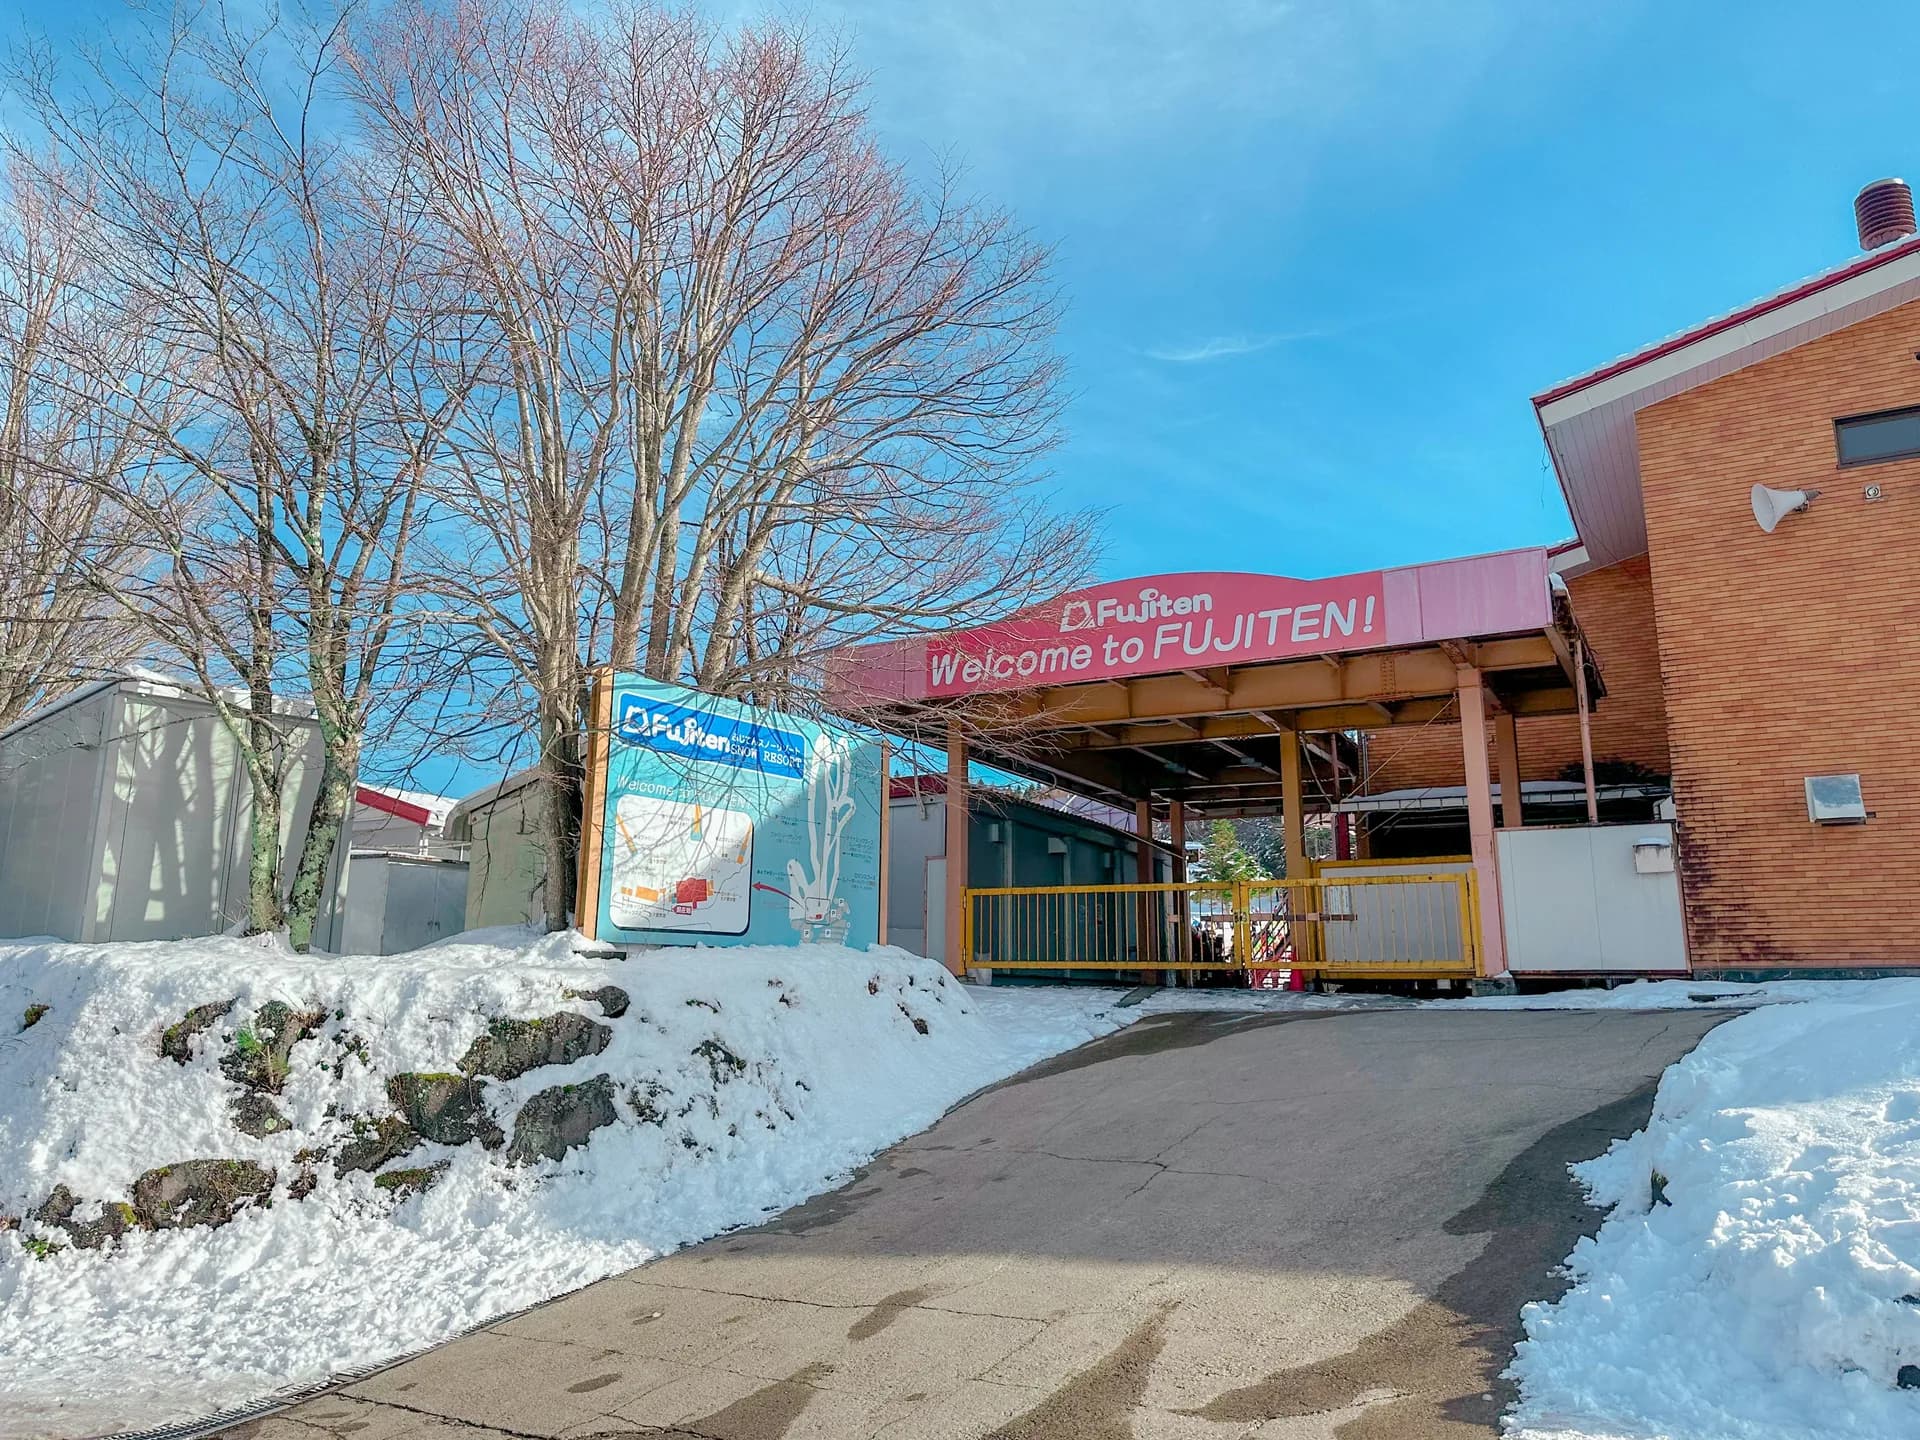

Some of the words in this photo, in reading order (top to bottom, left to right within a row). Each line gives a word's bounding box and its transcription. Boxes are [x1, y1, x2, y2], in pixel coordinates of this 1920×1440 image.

[1097, 588, 1213, 626] Fujiten
[931, 644, 1093, 687] Welcome
[1102, 634, 1145, 666] to
[1152, 595, 1376, 660] FUJITEN!
[652, 713, 732, 754] Fujiten
[730, 743, 758, 760] SNOW
[763, 751, 802, 768] RESORT
[616, 775, 674, 797] Welcome
